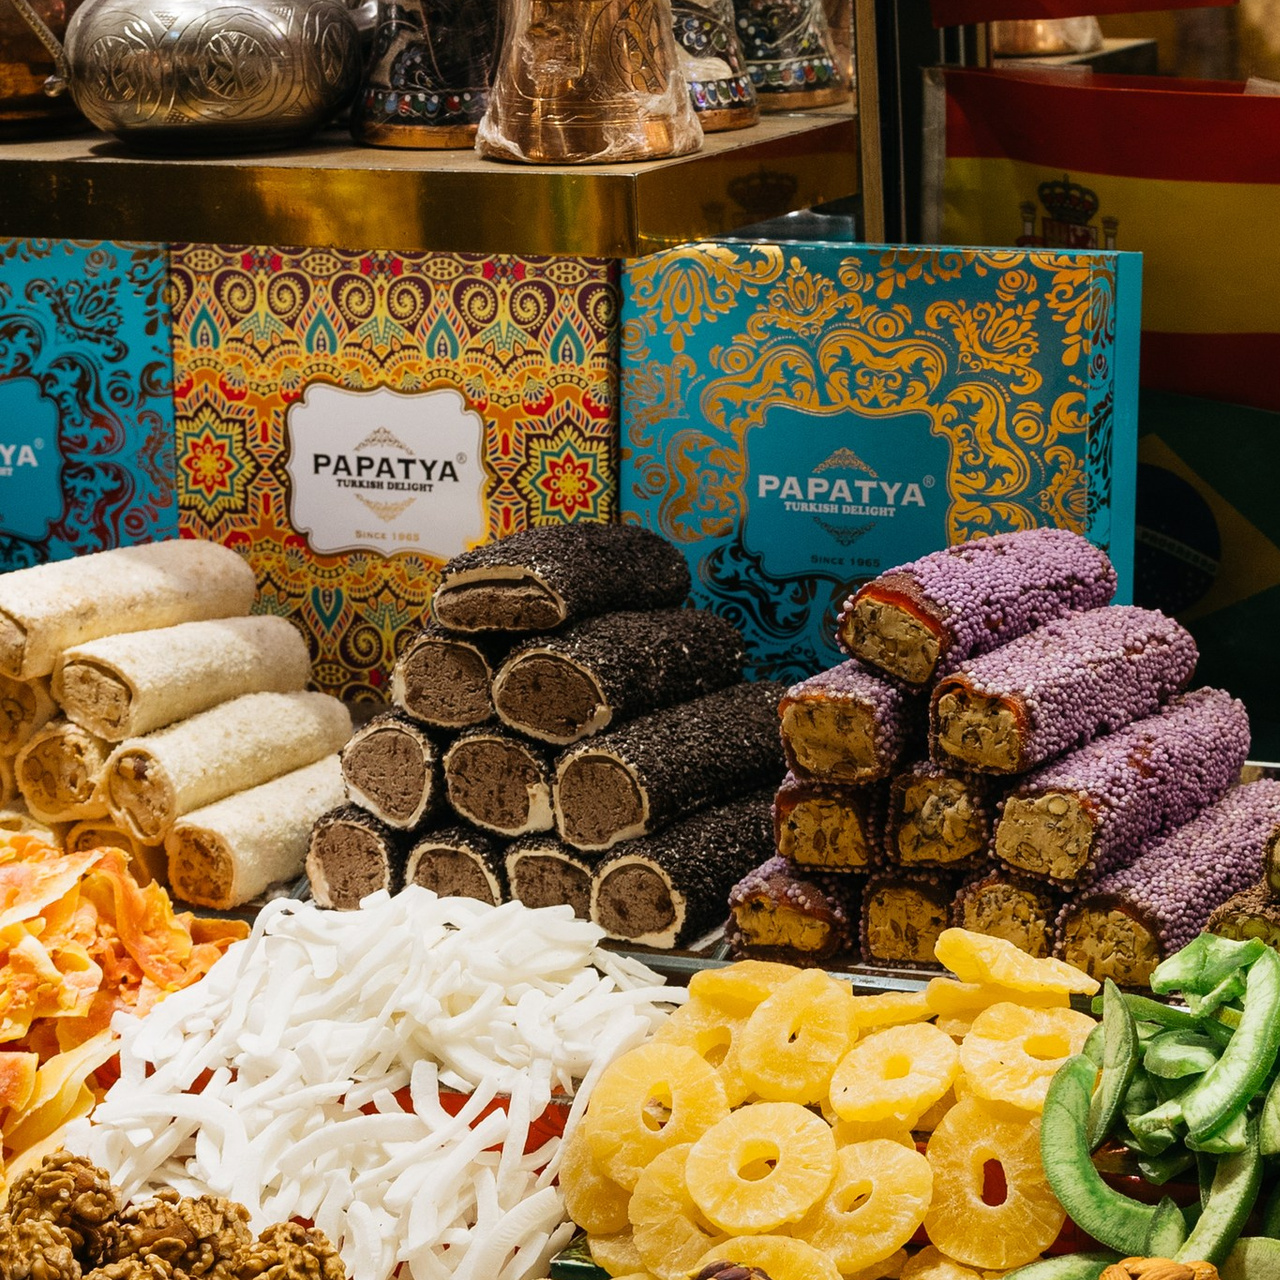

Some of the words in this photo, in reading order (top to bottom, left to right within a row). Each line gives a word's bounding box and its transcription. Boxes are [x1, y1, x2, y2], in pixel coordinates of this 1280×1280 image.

[313, 453, 460, 482] PAPATYA
[336, 478, 384, 490] TURKISH
[386, 480, 434, 493] DELIGHT
[757, 474, 926, 507] PAPATYA
[784, 501, 839, 515] TURKISH
[841, 504, 896, 518] DELIGHT
[850, 557, 881, 568] 1965
